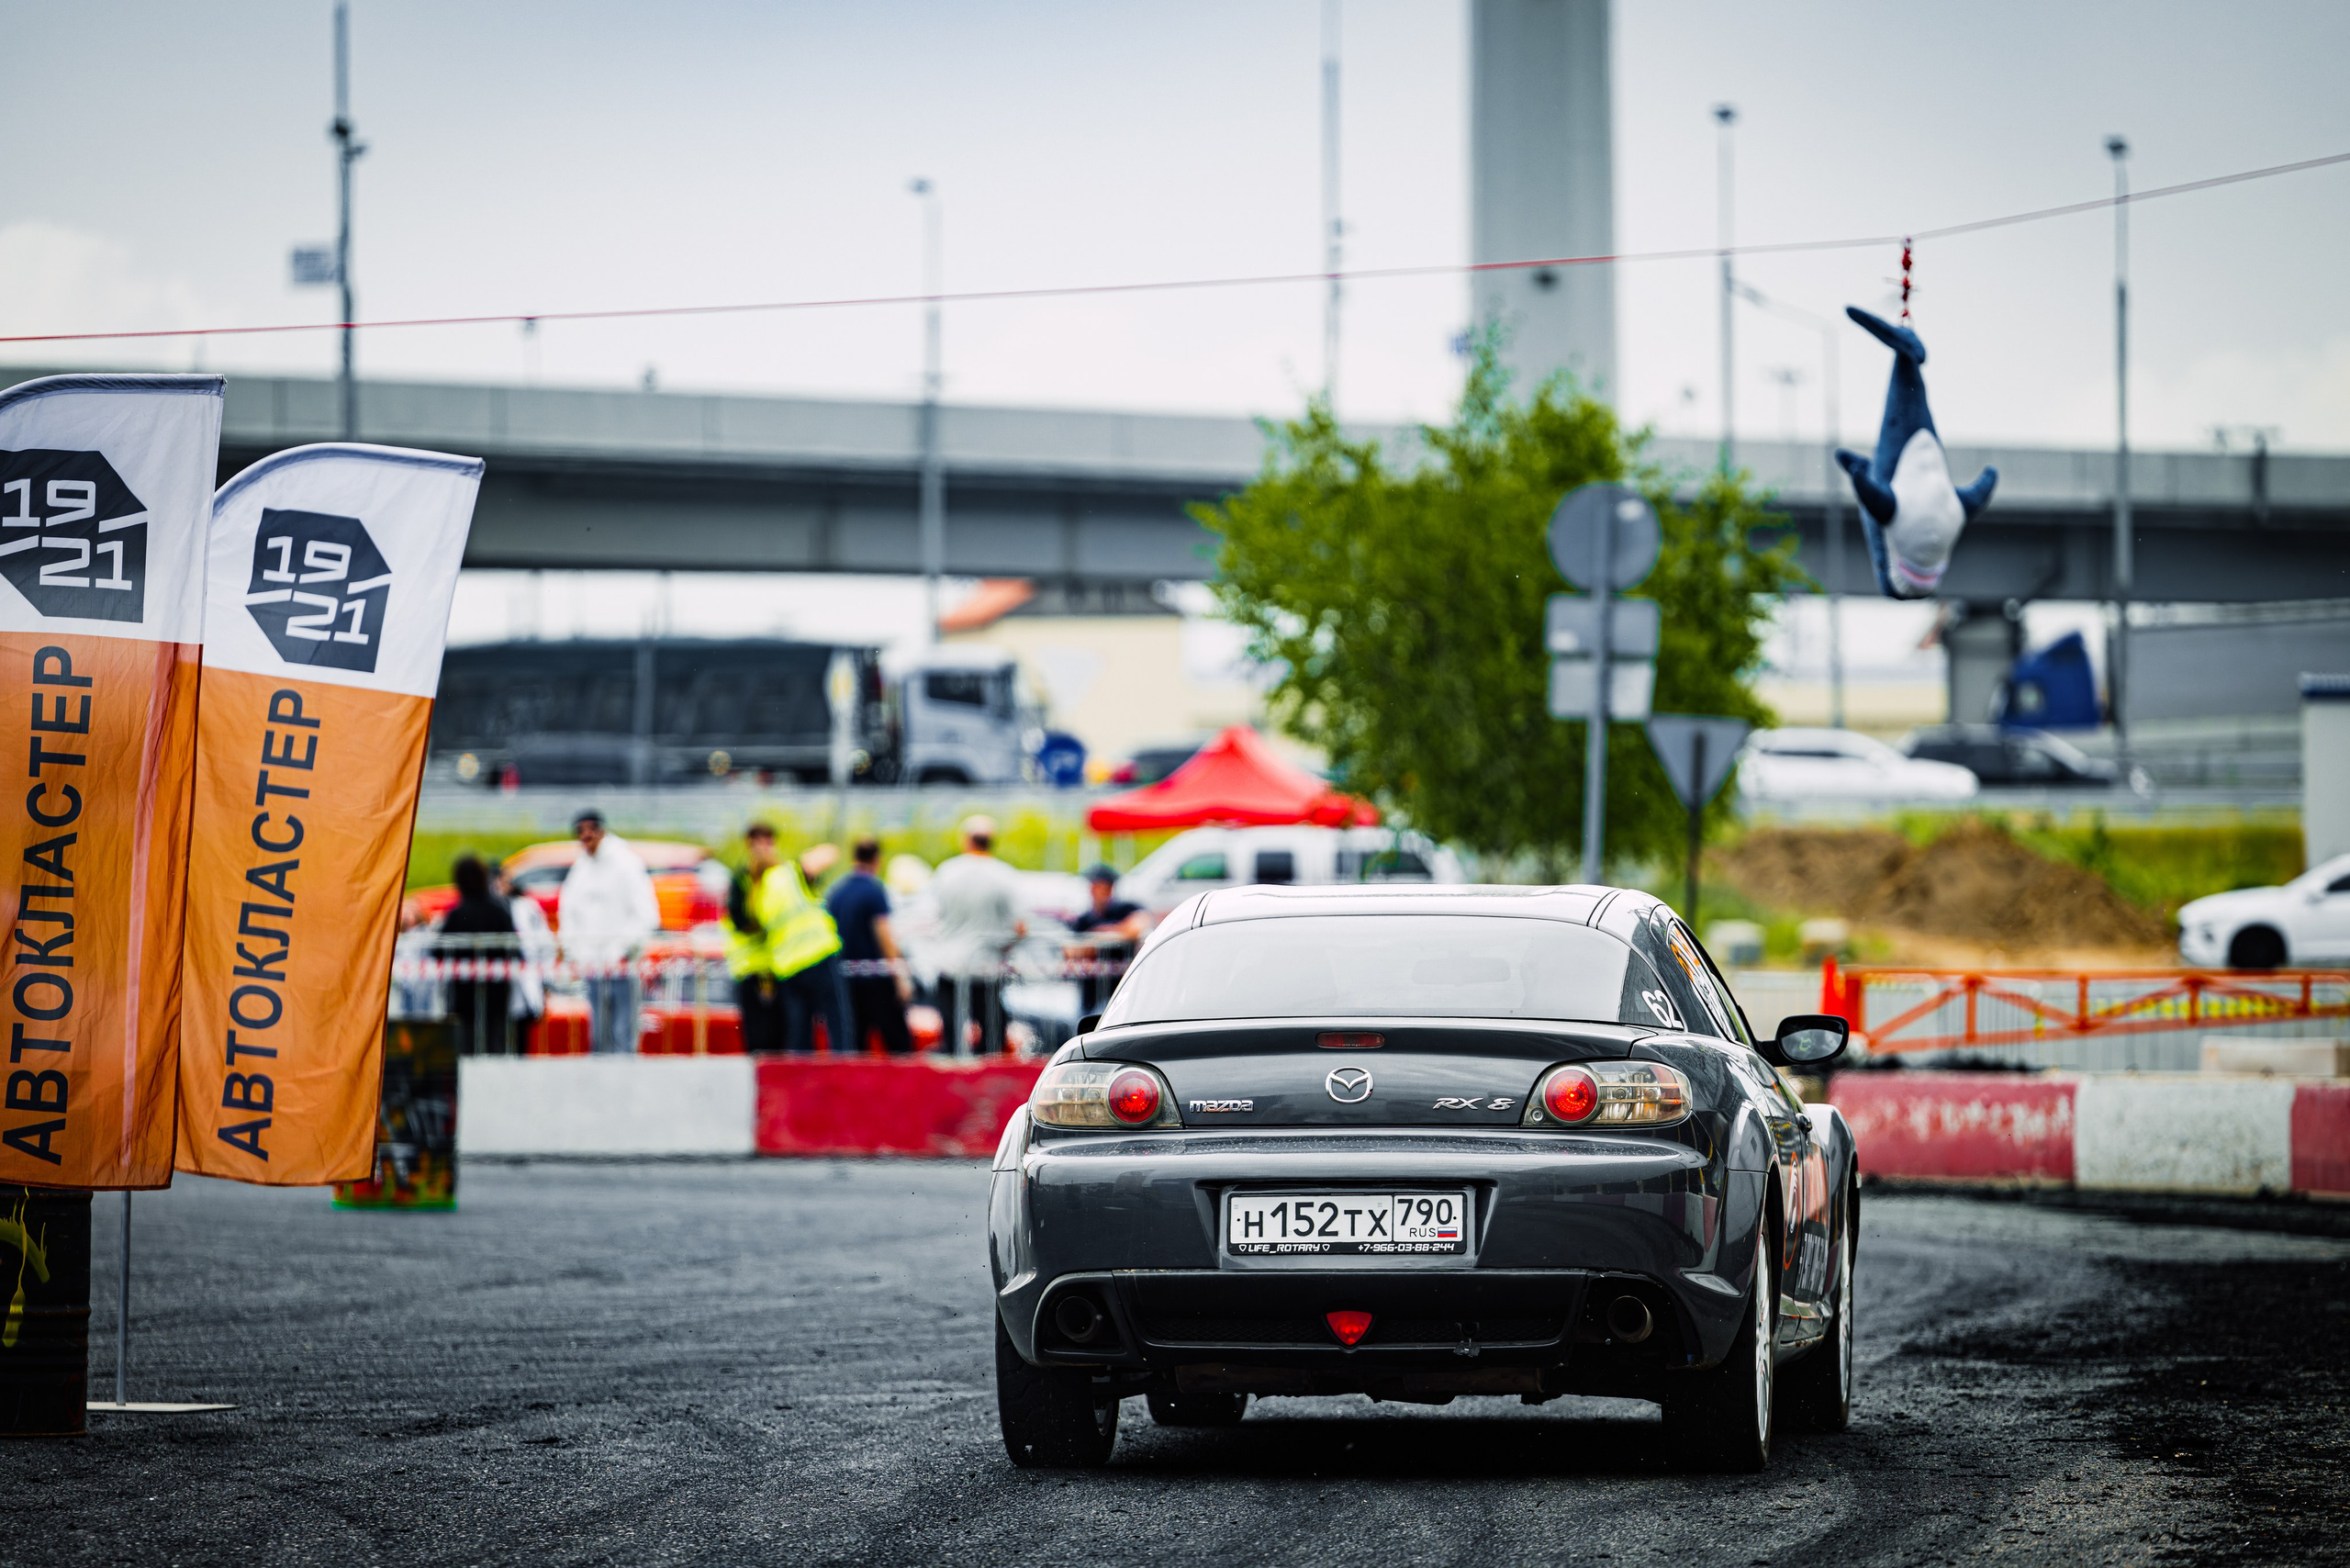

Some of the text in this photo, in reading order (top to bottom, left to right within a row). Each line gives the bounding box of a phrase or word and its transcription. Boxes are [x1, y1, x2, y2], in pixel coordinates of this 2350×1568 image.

[3, 478, 96, 528] 19
[39, 536, 133, 591] 21
[263, 535, 352, 585] 19
[285, 589, 369, 645] 21
[3, 644, 93, 1166] АВТОКЛАСТЕР
[218, 689, 320, 1162] АВТОКЛАСТЕР
[1641, 989, 1684, 1029] 62
[1396, 1198, 1453, 1226] 790
[1408, 1226, 1438, 1238] RUS
[1357, 1242, 1455, 1252] +7-966-03-88-244
